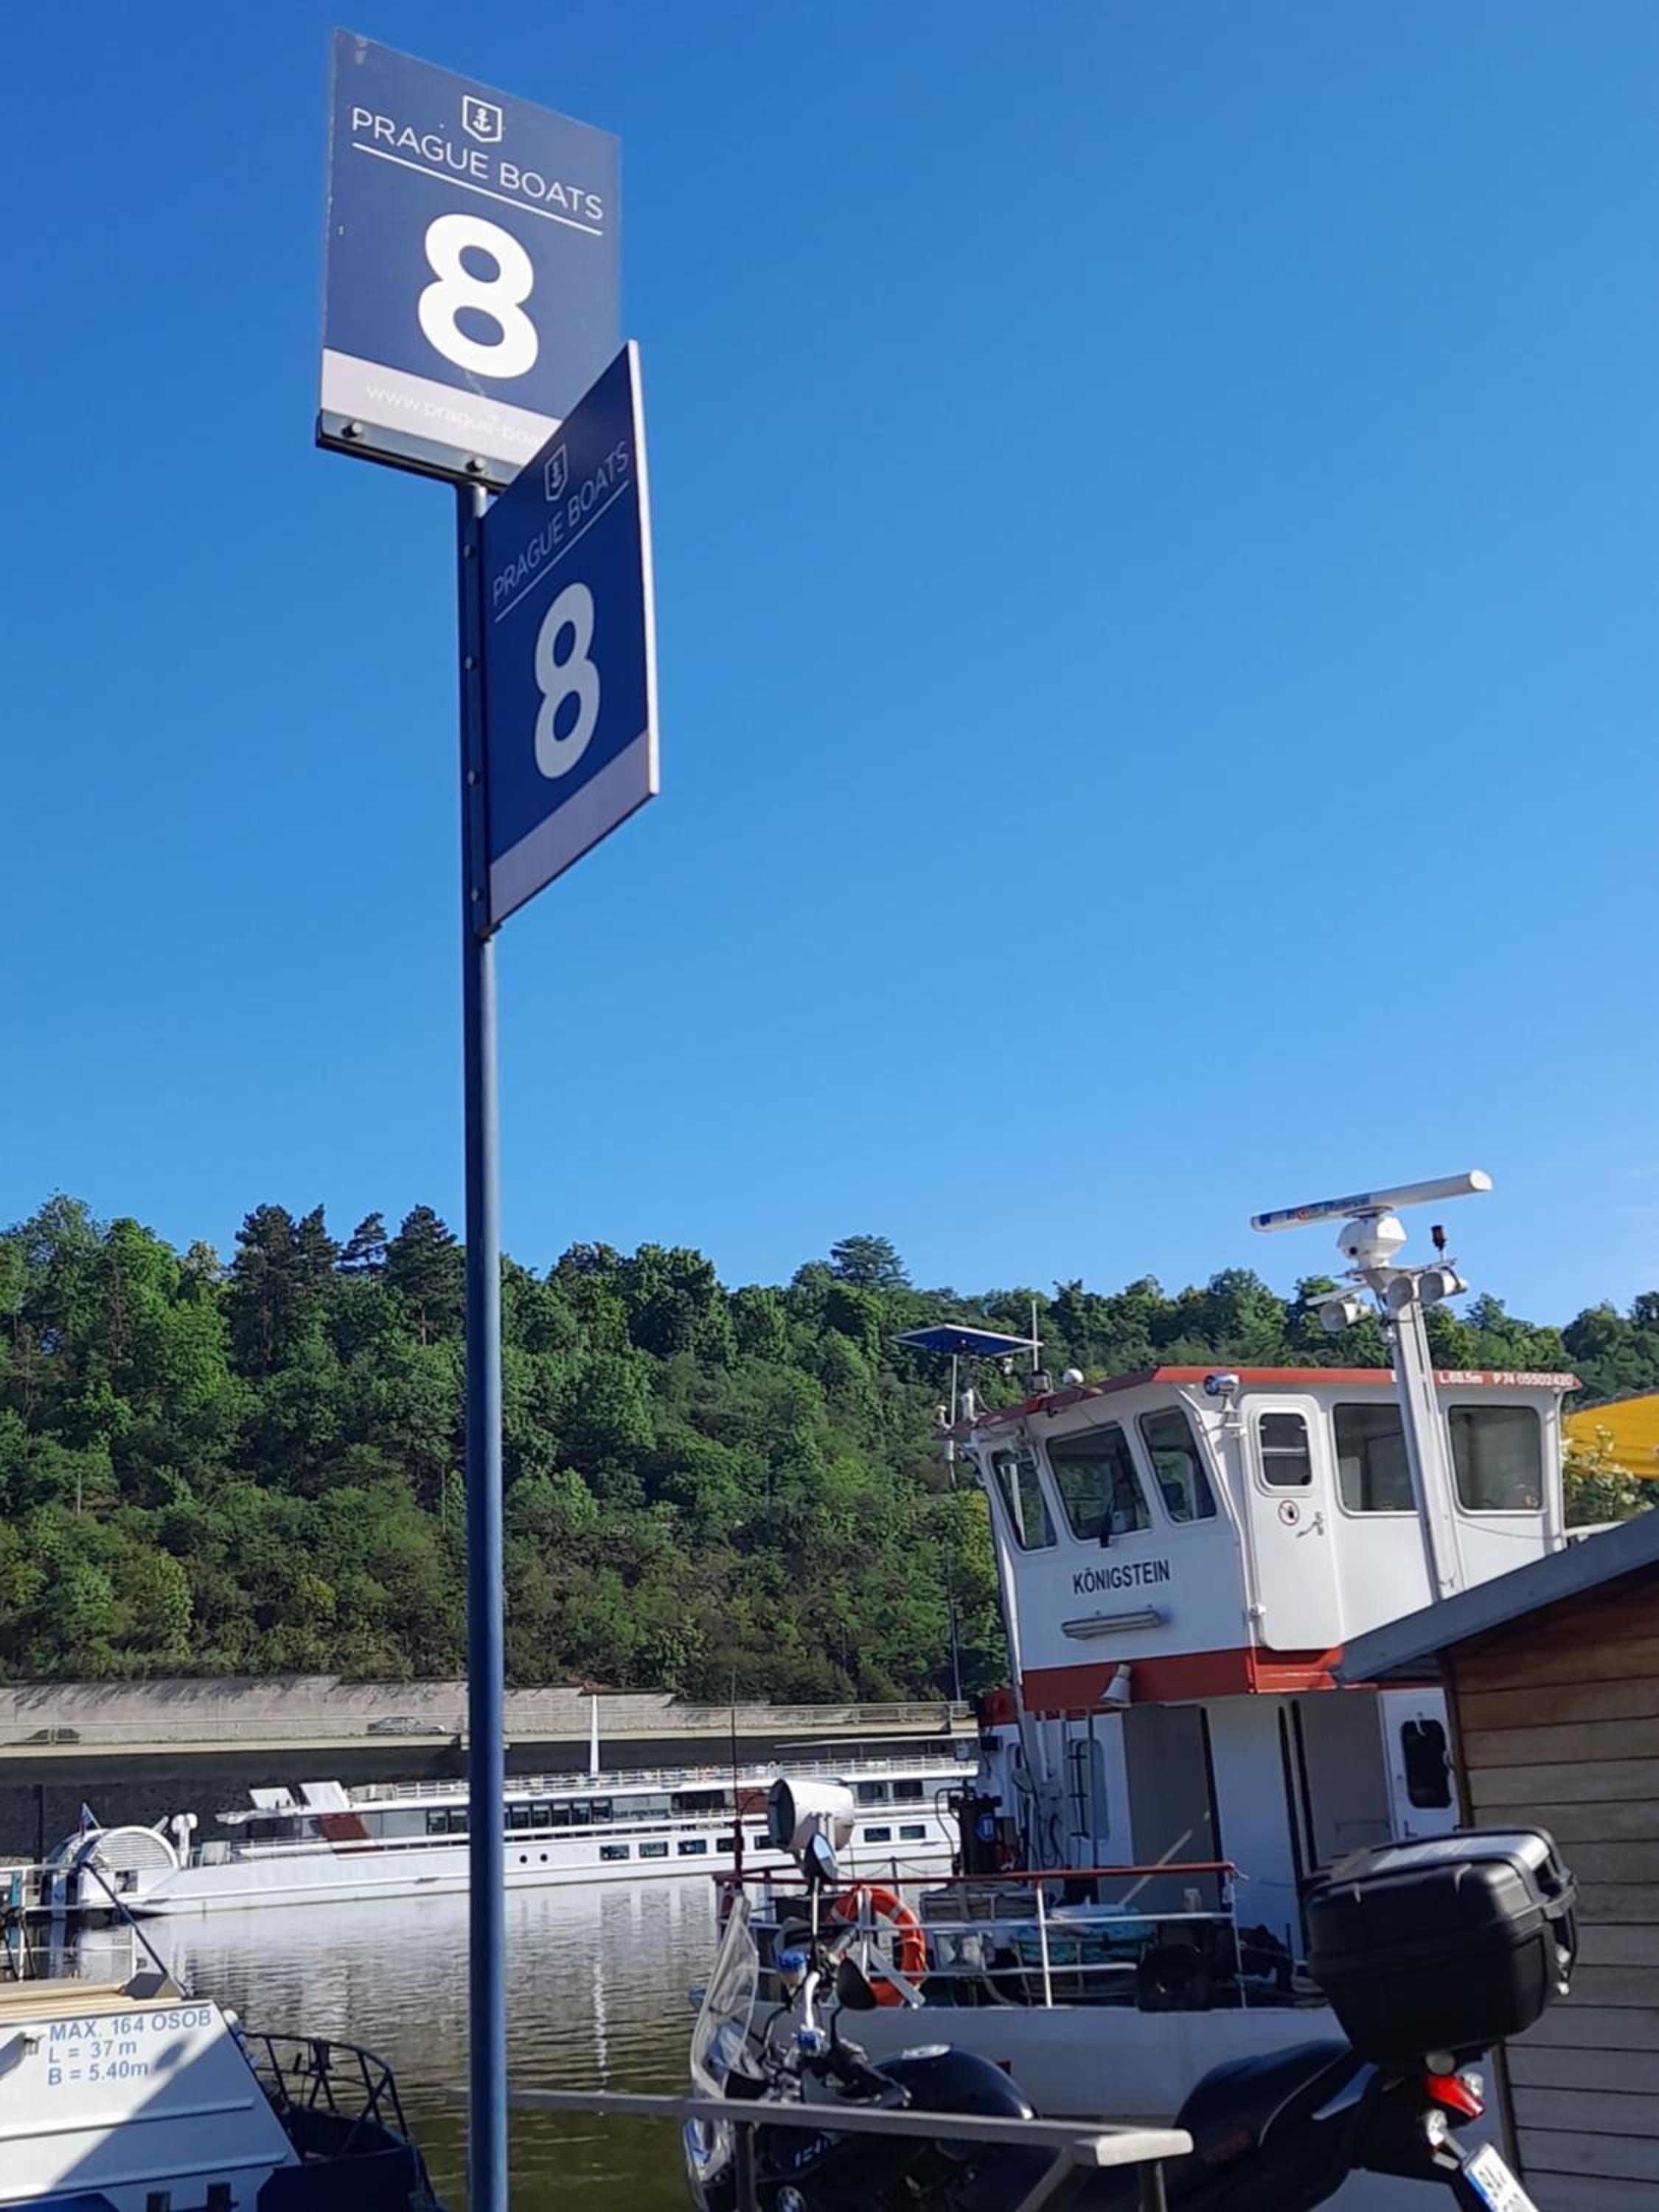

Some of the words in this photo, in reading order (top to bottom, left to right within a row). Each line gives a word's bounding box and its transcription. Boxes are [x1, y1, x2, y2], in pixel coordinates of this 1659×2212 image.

[353, 107, 490, 179] PRAGUE
[499, 161, 603, 220] BOATS
[418, 213, 539, 378] 8
[493, 511, 565, 606] PRAGUE
[567, 441, 629, 527] BOATS
[535, 582, 599, 779] 8
[1073, 1559, 1170, 1594] KÖNIGSTEIN
[48, 2046, 60, 2063] L
[69, 2048, 79, 2057] =
[91, 2040, 114, 2058] 37
[119, 2041, 137, 2055] m
[49, 2020, 102, 2042] MAX.
[111, 2017, 145, 2034] 164
[151, 2009, 212, 2031] OSOB
[48, 2067, 62, 2086] B
[70, 2070, 81, 2079] =
[89, 2061, 150, 2081] 5.40m
